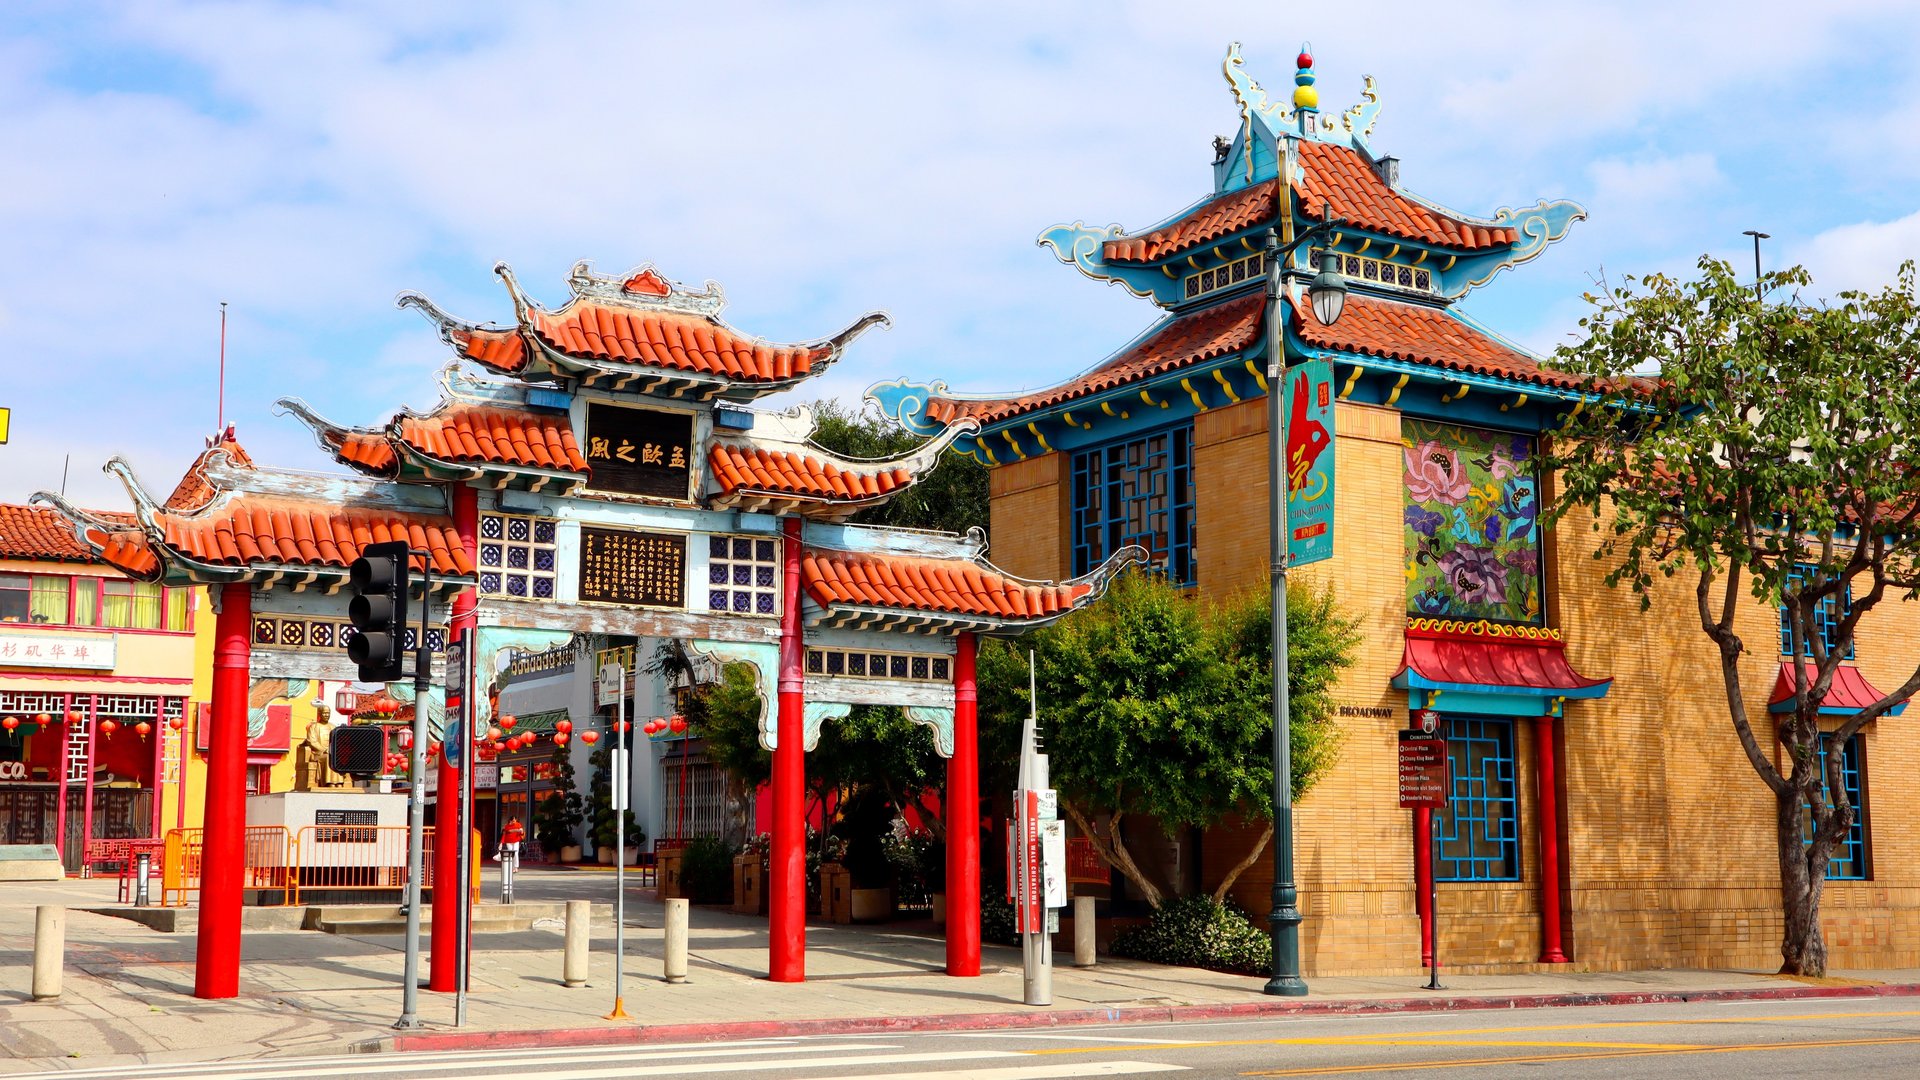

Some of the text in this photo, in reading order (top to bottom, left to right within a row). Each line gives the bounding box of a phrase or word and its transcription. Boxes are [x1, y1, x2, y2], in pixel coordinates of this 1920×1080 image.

[1290, 503, 1331, 519] CHINATOWN
[2, 642, 90, 661] 杉矶华埠
[1340, 706, 1393, 718] BROADWAY
